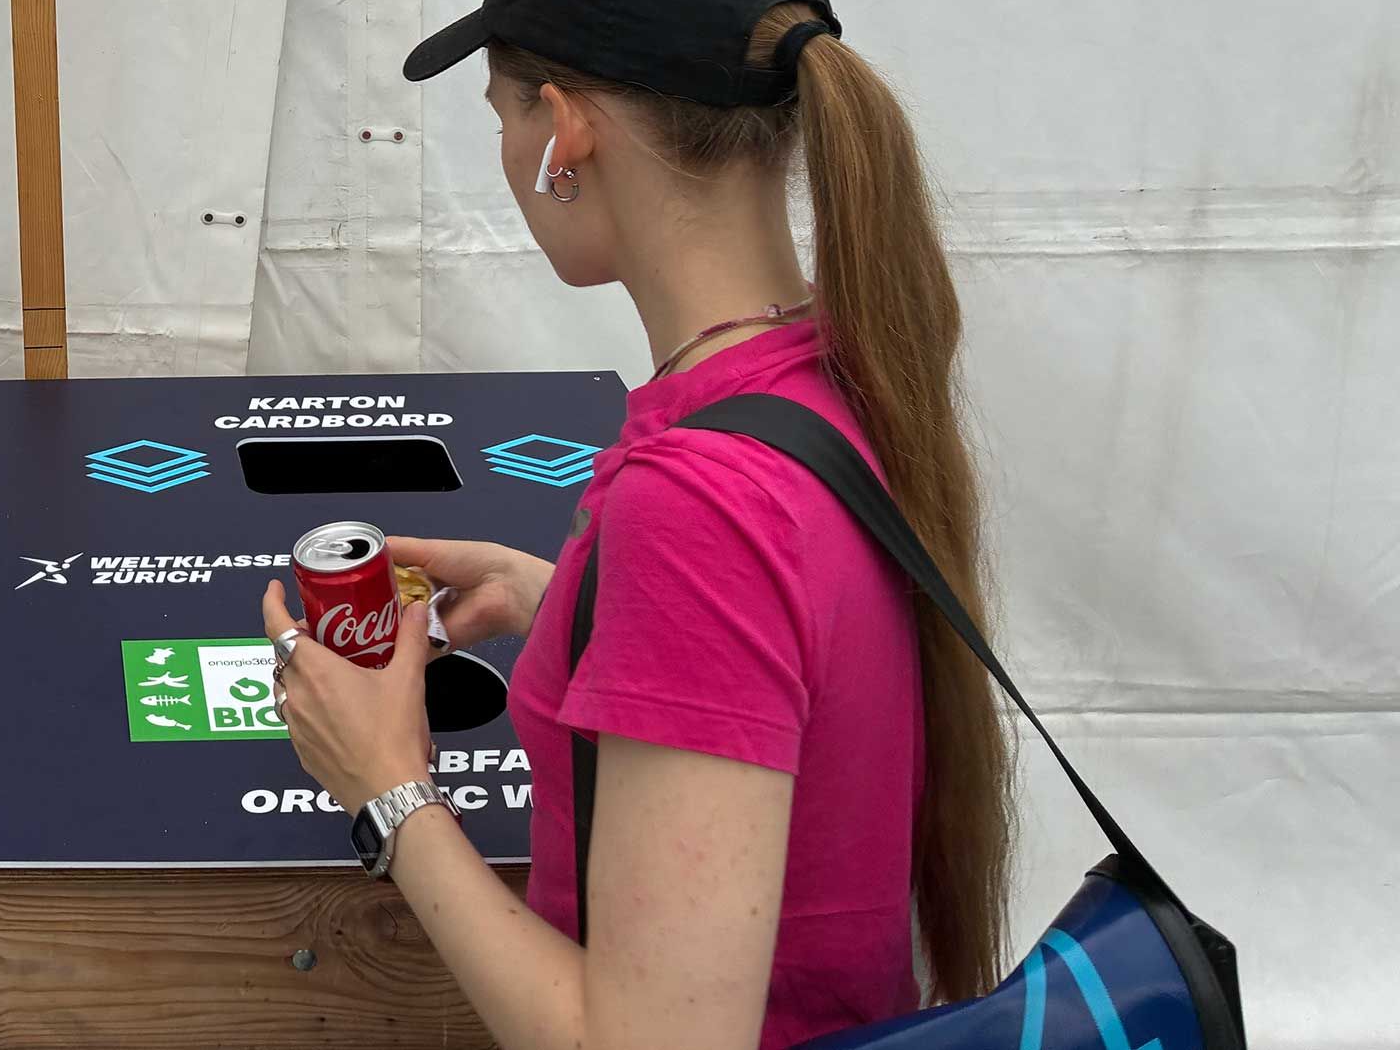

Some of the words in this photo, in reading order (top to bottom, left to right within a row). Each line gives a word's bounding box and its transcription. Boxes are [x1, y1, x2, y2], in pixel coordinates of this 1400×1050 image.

[249, 396, 405, 410] KARTON
[214, 413, 453, 429] CARDBOARD
[90, 554, 292, 569] WELTKLASSE
[92, 569, 212, 584] ZÜRICH
